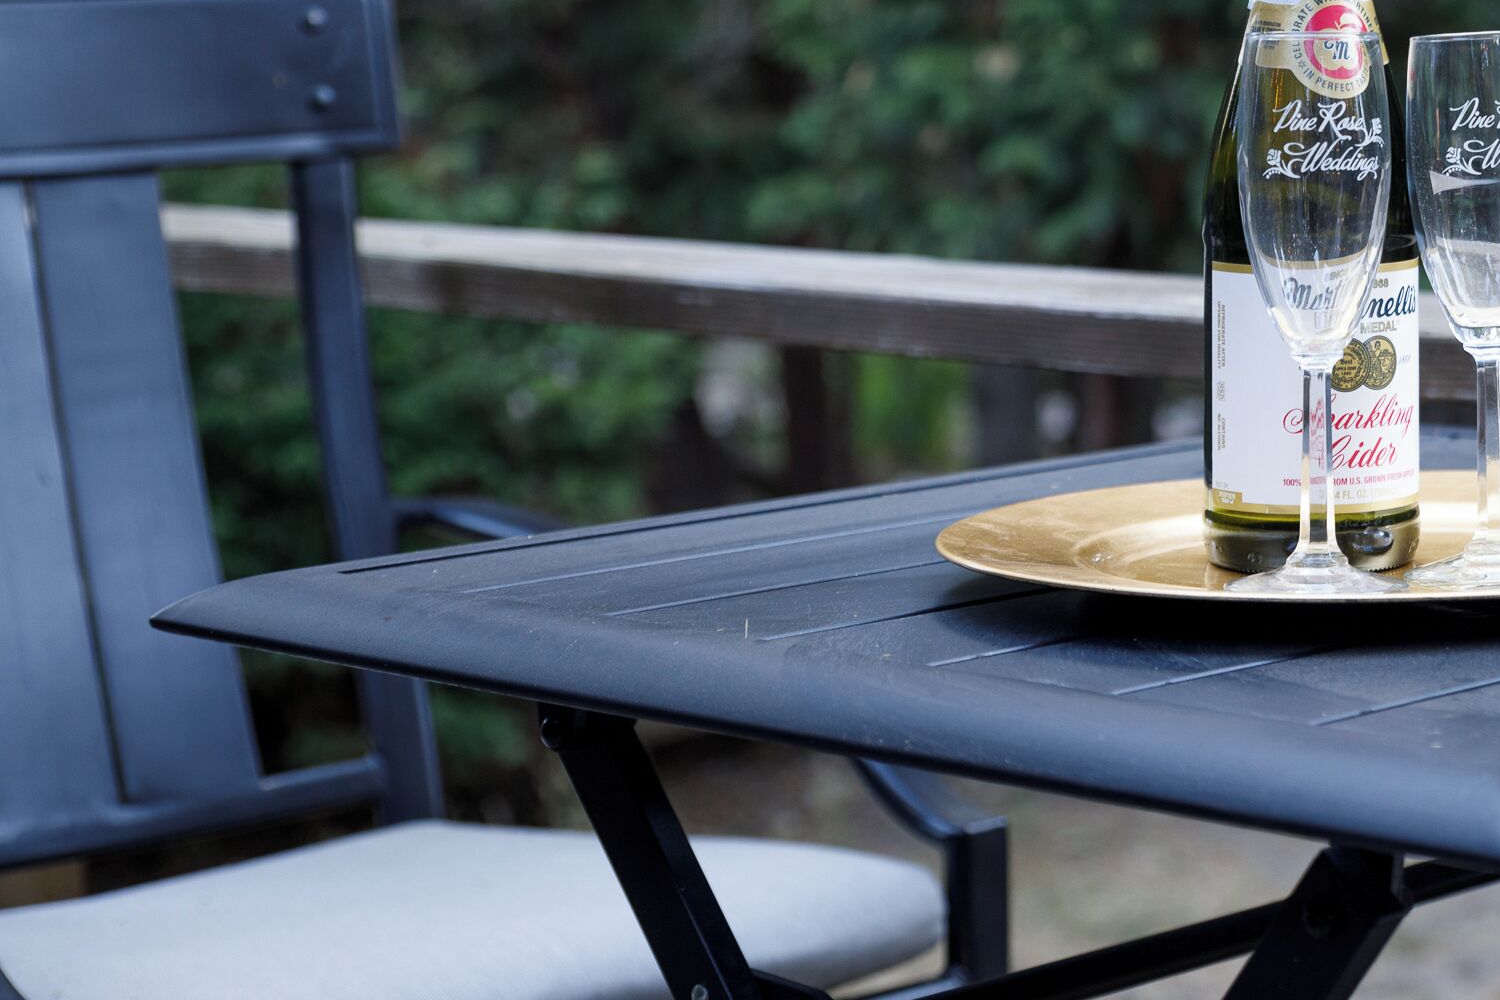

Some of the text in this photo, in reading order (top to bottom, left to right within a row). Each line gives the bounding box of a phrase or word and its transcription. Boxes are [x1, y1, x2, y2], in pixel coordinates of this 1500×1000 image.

[1291, 3, 1314, 59] CELBRATE
[1303, 68, 1314, 80] IN
[1315, 78, 1356, 93] PERFECT
[1272, 99, 1364, 141] Pine Rose
[1448, 97, 1496, 131] Pine
[1283, 138, 1380, 181] Weddings
[1284, 277, 1416, 319] Martnelli's
[1372, 278, 1389, 289] 868
[1360, 320, 1397, 334] MEDAL
[1331, 434, 1398, 471] Cider
[1283, 478, 1301, 487] 100%
[1333, 477, 1347, 486] ROM
[1350, 477, 1362, 485] U.S.
[1364, 474, 1386, 484] GROWN
